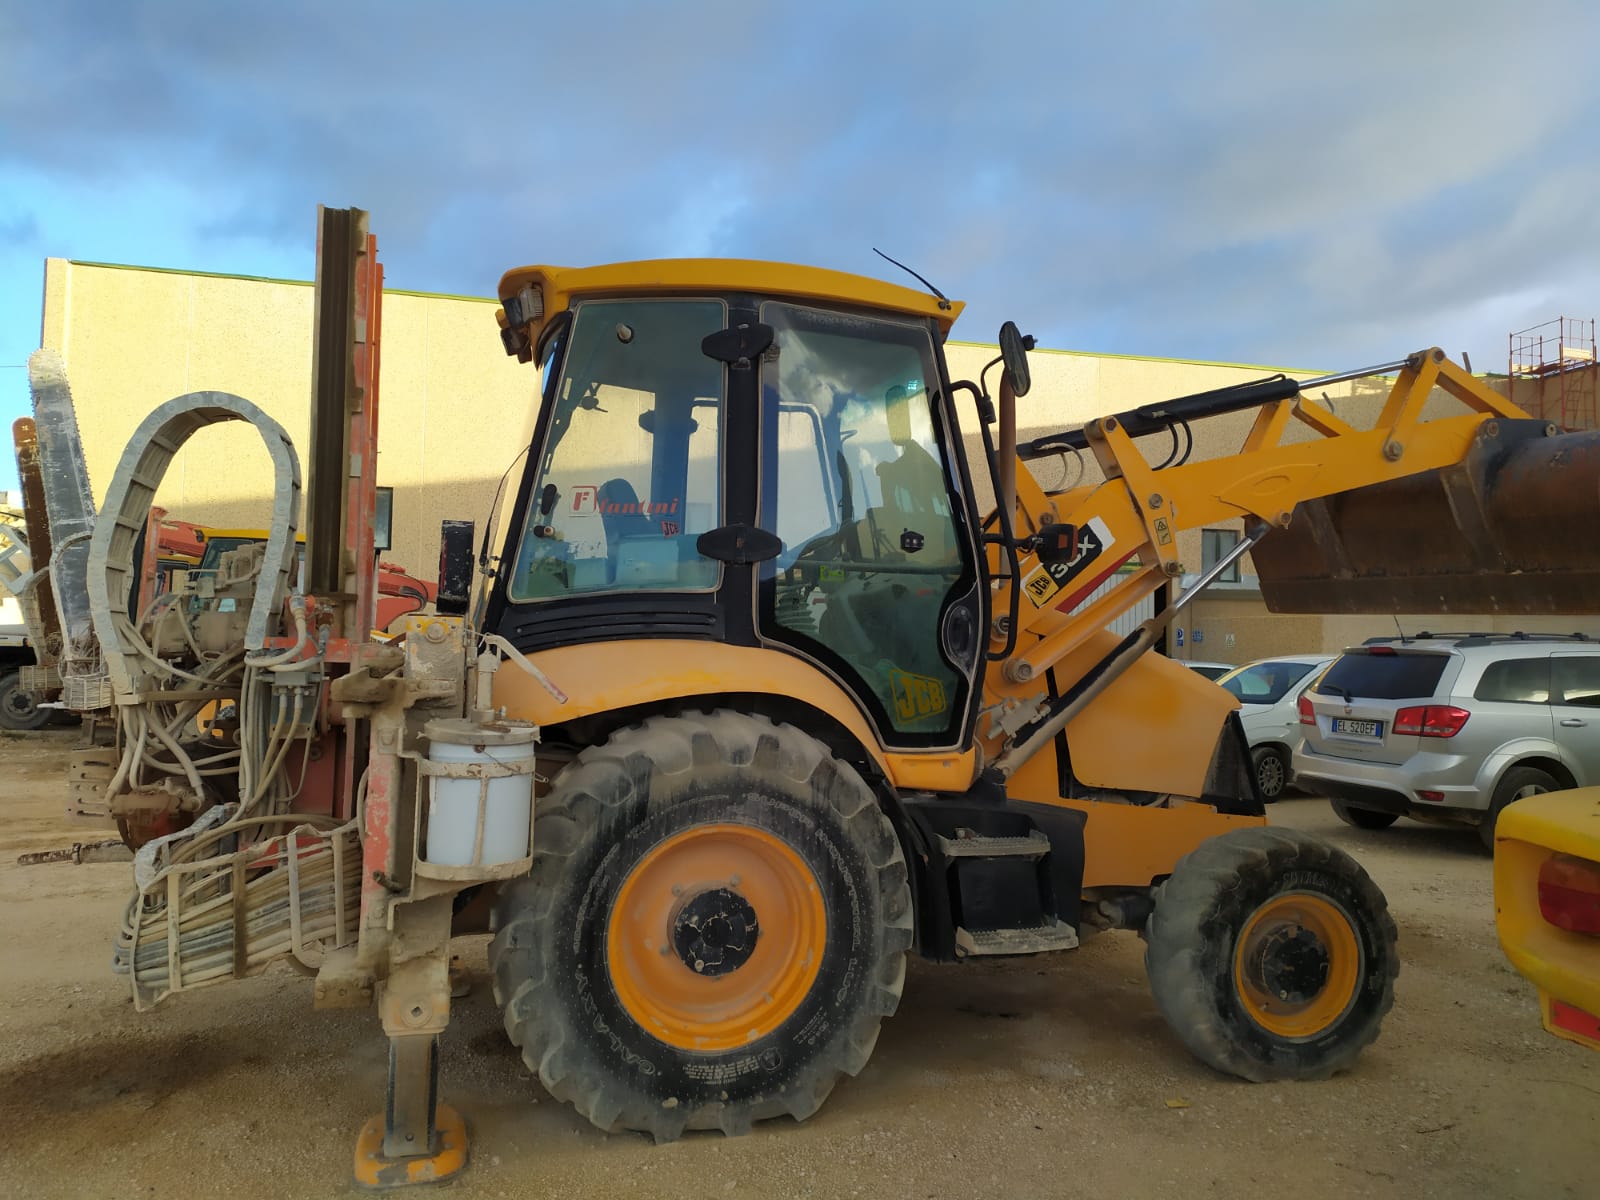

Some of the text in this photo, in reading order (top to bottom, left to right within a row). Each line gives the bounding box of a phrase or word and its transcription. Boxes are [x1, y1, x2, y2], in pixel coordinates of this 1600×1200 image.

[1030, 576, 1050, 596] JCB
[900, 676, 943, 719] JCB
[574, 969, 656, 1075] GALAXY
